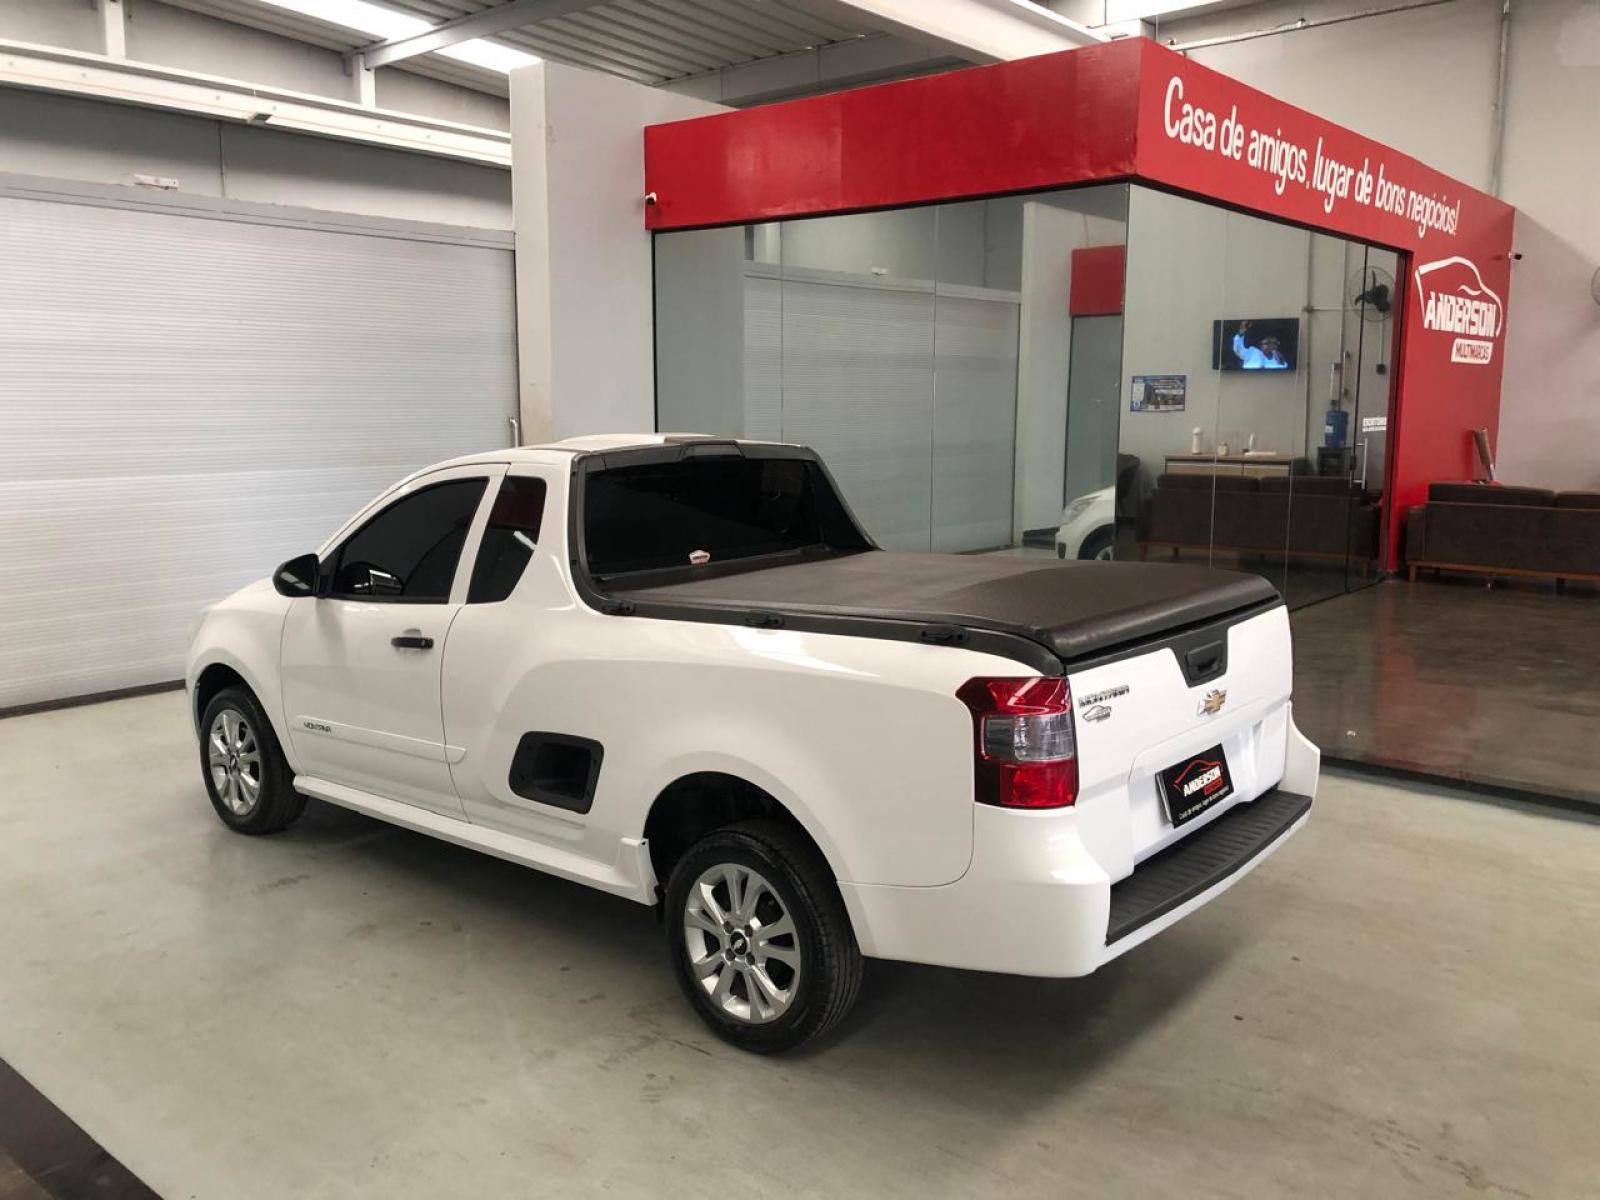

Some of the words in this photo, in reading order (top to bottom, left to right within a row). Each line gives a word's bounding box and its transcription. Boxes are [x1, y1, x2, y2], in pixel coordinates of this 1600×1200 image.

[1164, 76, 1216, 150] Casa
[1220, 104, 1245, 160] de
[1247, 128, 1310, 195] amigos,
[1312, 136, 1354, 213] lugar
[1354, 158, 1373, 205] de
[1374, 163, 1405, 216] bons
[1406, 193, 1460, 239] negócios!
[1424, 291, 1496, 337] ANDERSON
[1183, 765, 1222, 797] ANDERSON
